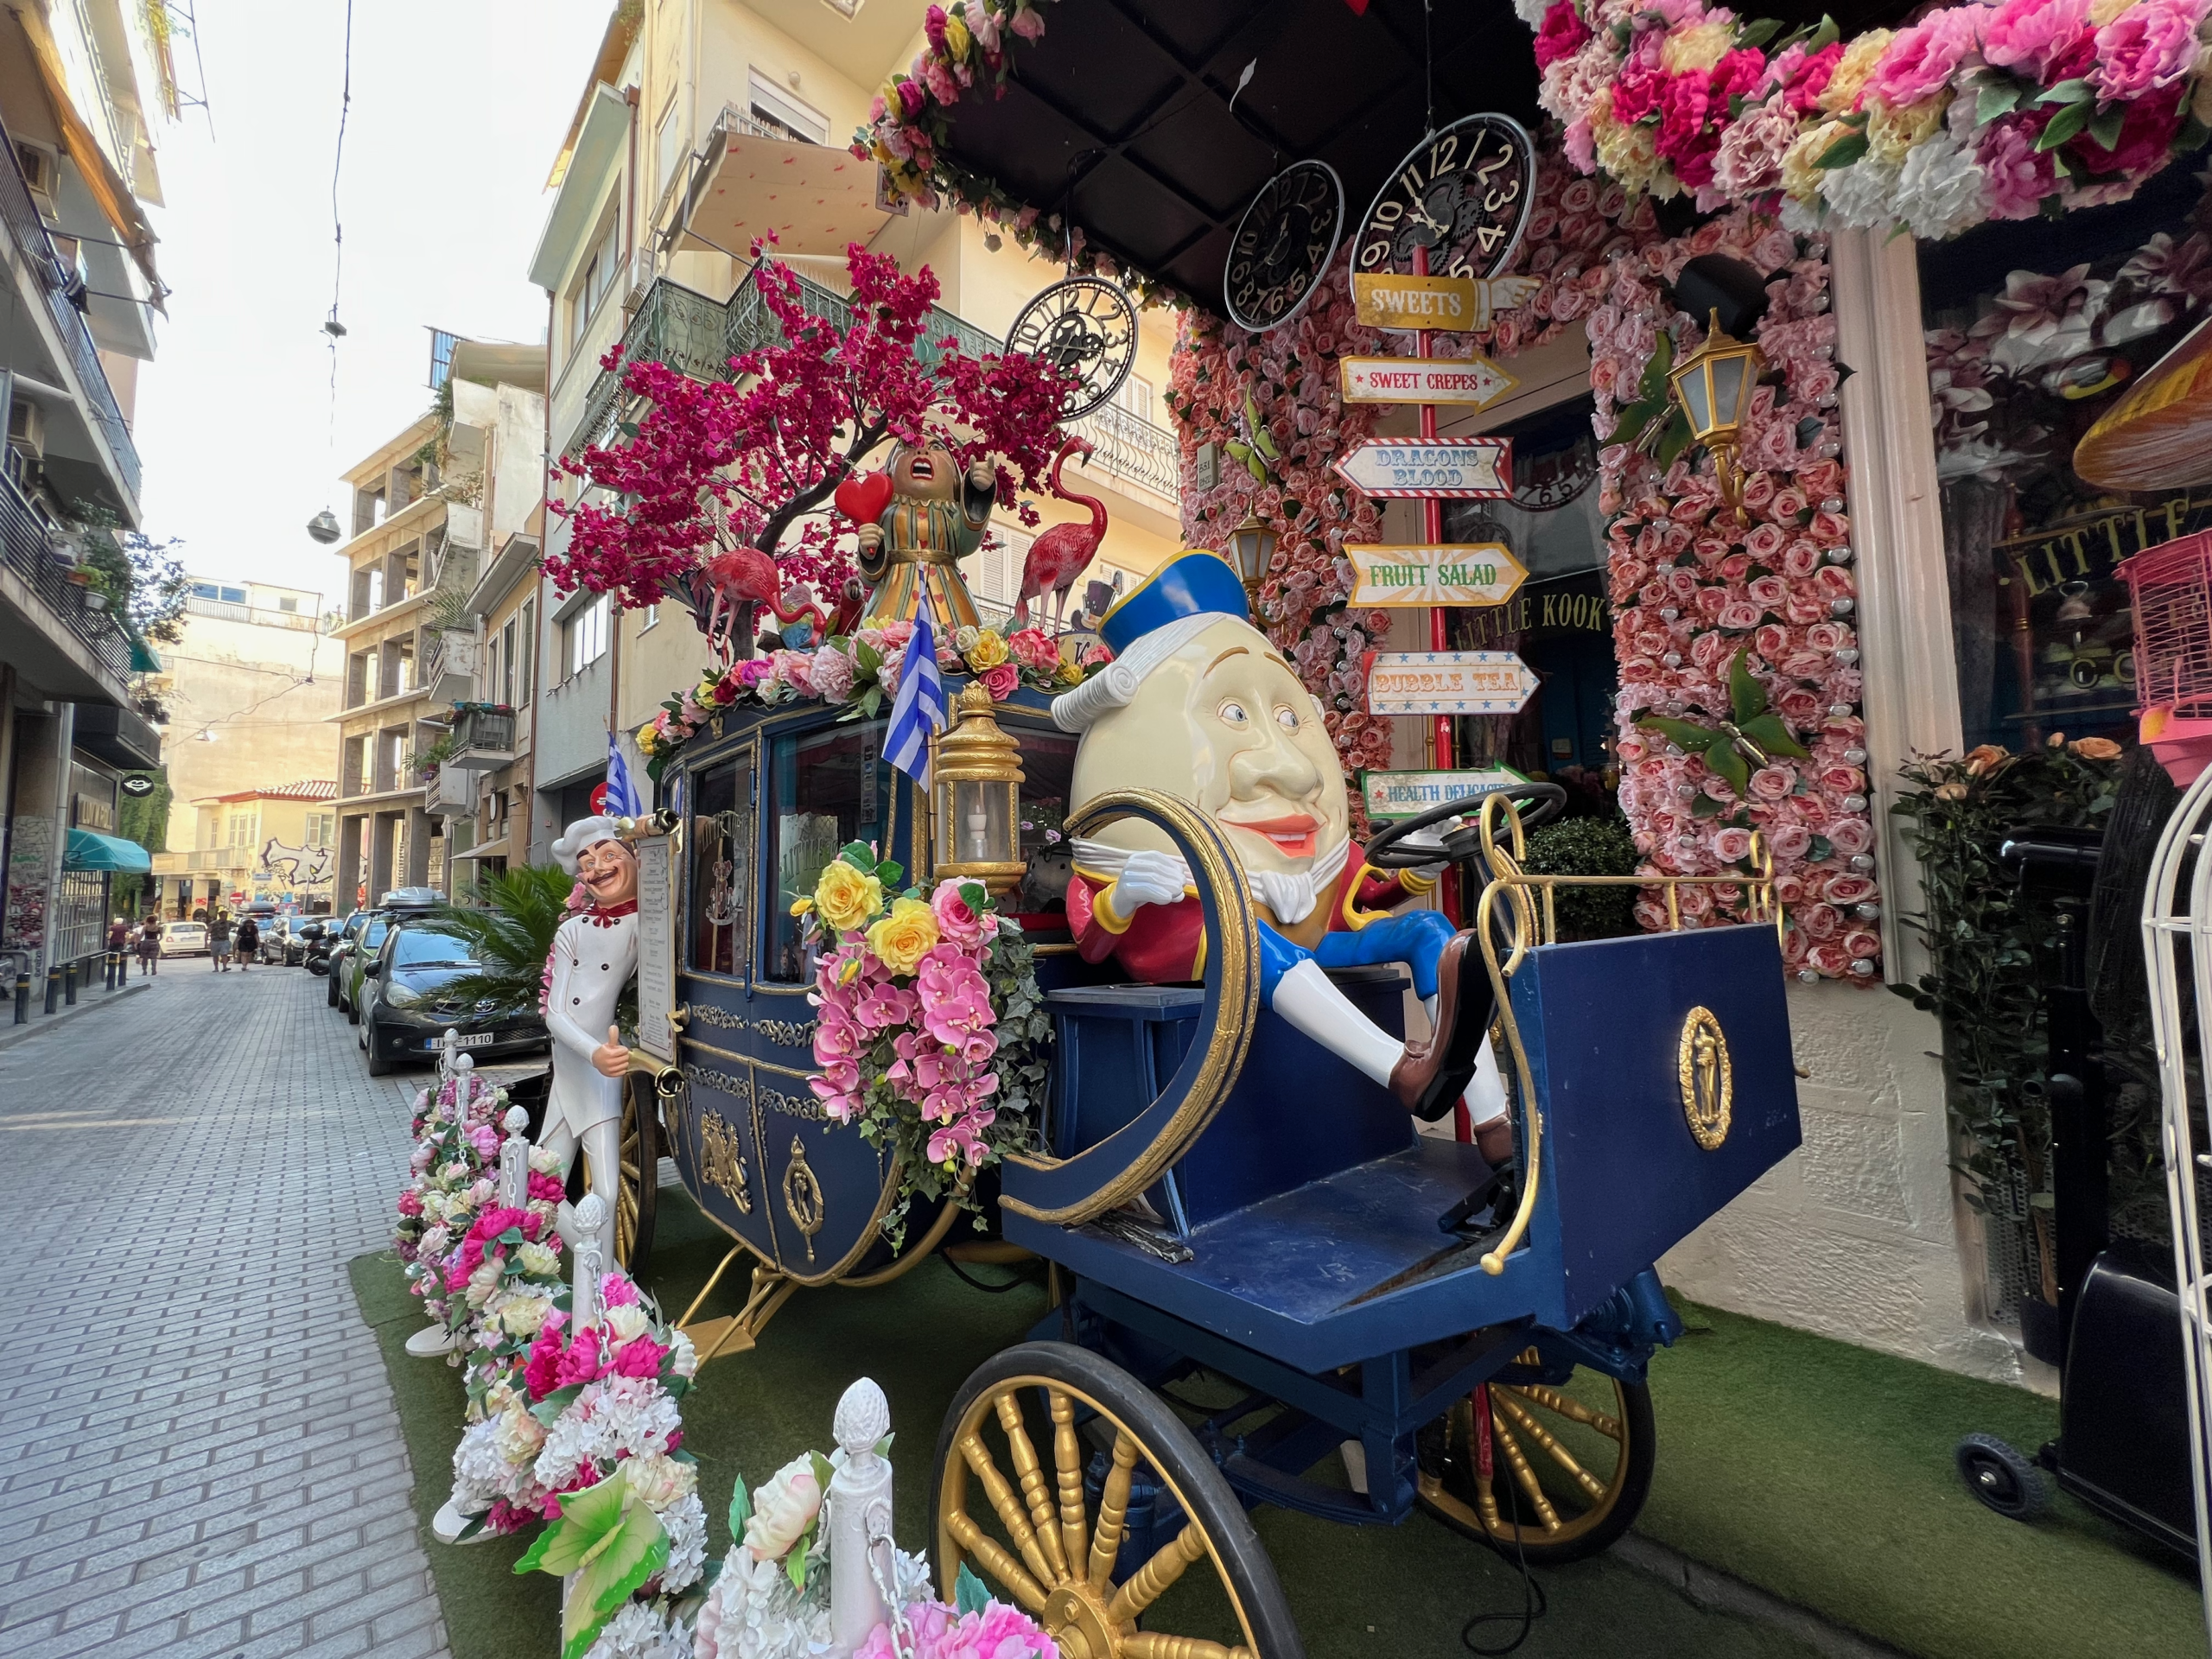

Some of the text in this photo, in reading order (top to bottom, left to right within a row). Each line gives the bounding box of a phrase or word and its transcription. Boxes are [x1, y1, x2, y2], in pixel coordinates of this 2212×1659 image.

[1429, 134, 1459, 180] 12
[1464, 128, 1487, 170] 1
[1477, 143, 1514, 187] 2
[1399, 163, 1425, 198] 11
[1483, 179, 1520, 213] 3
[1310, 207, 1333, 234] 3
[1370, 200, 1404, 232] 10
[1477, 223, 1507, 253] 4
[1306, 241, 1325, 265] 4
[1360, 239, 1391, 268] 9
[1236, 281, 1255, 308] 8
[1289, 266, 1306, 296] 5
[1036, 299, 1058, 326] 11
[1058, 286, 1080, 317] 12
[1085, 288, 1102, 315] 1
[1270, 286, 1285, 315] 6
[1370, 289, 1462, 317] SWEETS
[1096, 302, 1122, 330] 2
[1014, 322, 1042, 347] 10
[1103, 328, 1128, 349] 3
[1100, 355, 1123, 378] 4
[1370, 372, 1478, 391] SWEET CREPES
[1375, 448, 1479, 467] DRAGONS
[1392, 468, 1463, 487] BLOOD
[1369, 563, 1497, 588] FRUIT SALAD
[1542, 592, 1607, 632] KOOK
[1375, 671, 1518, 694] BUBBLE TEA
[1388, 785, 1440, 802] HEALTH
